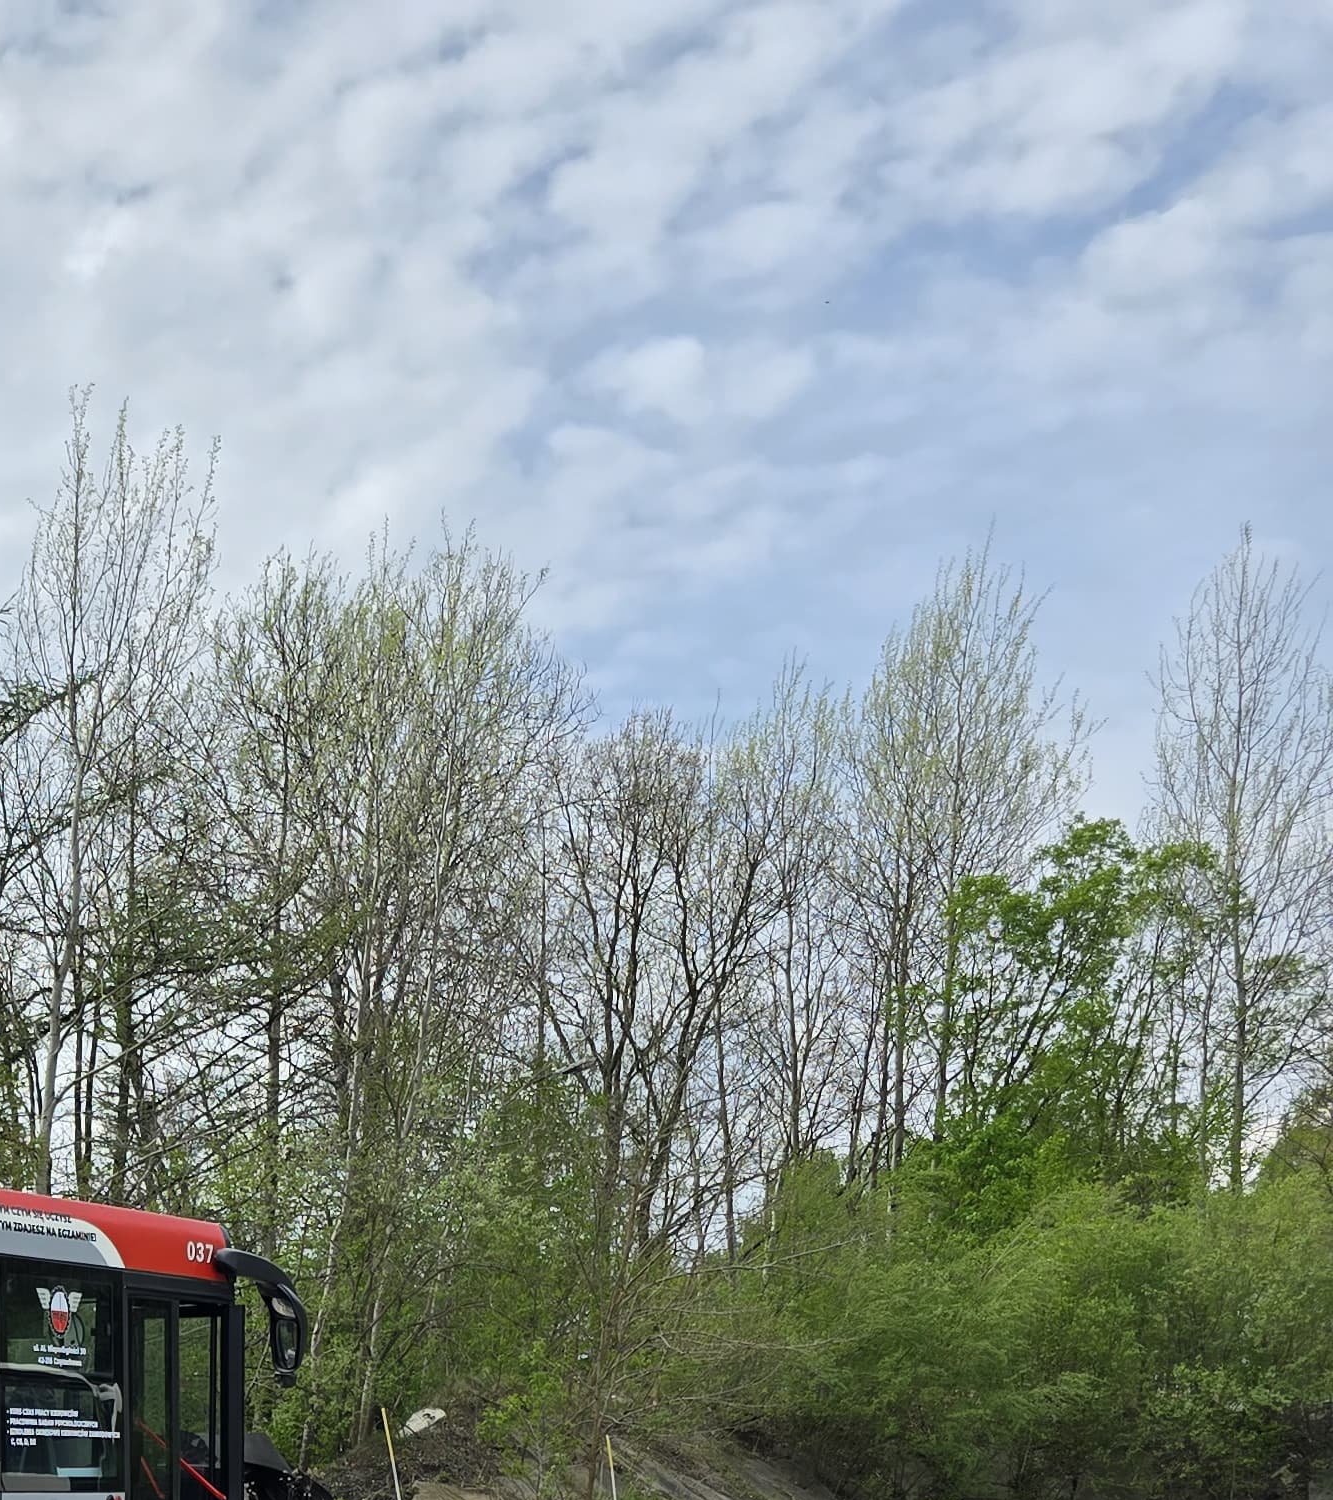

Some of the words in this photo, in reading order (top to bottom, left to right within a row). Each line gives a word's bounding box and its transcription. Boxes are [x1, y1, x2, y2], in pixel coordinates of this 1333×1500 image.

[13, 1221, 45, 1235] ZDAJESZ
[46, 1226, 57, 1237] NA
[187, 1241, 214, 1264] 037
